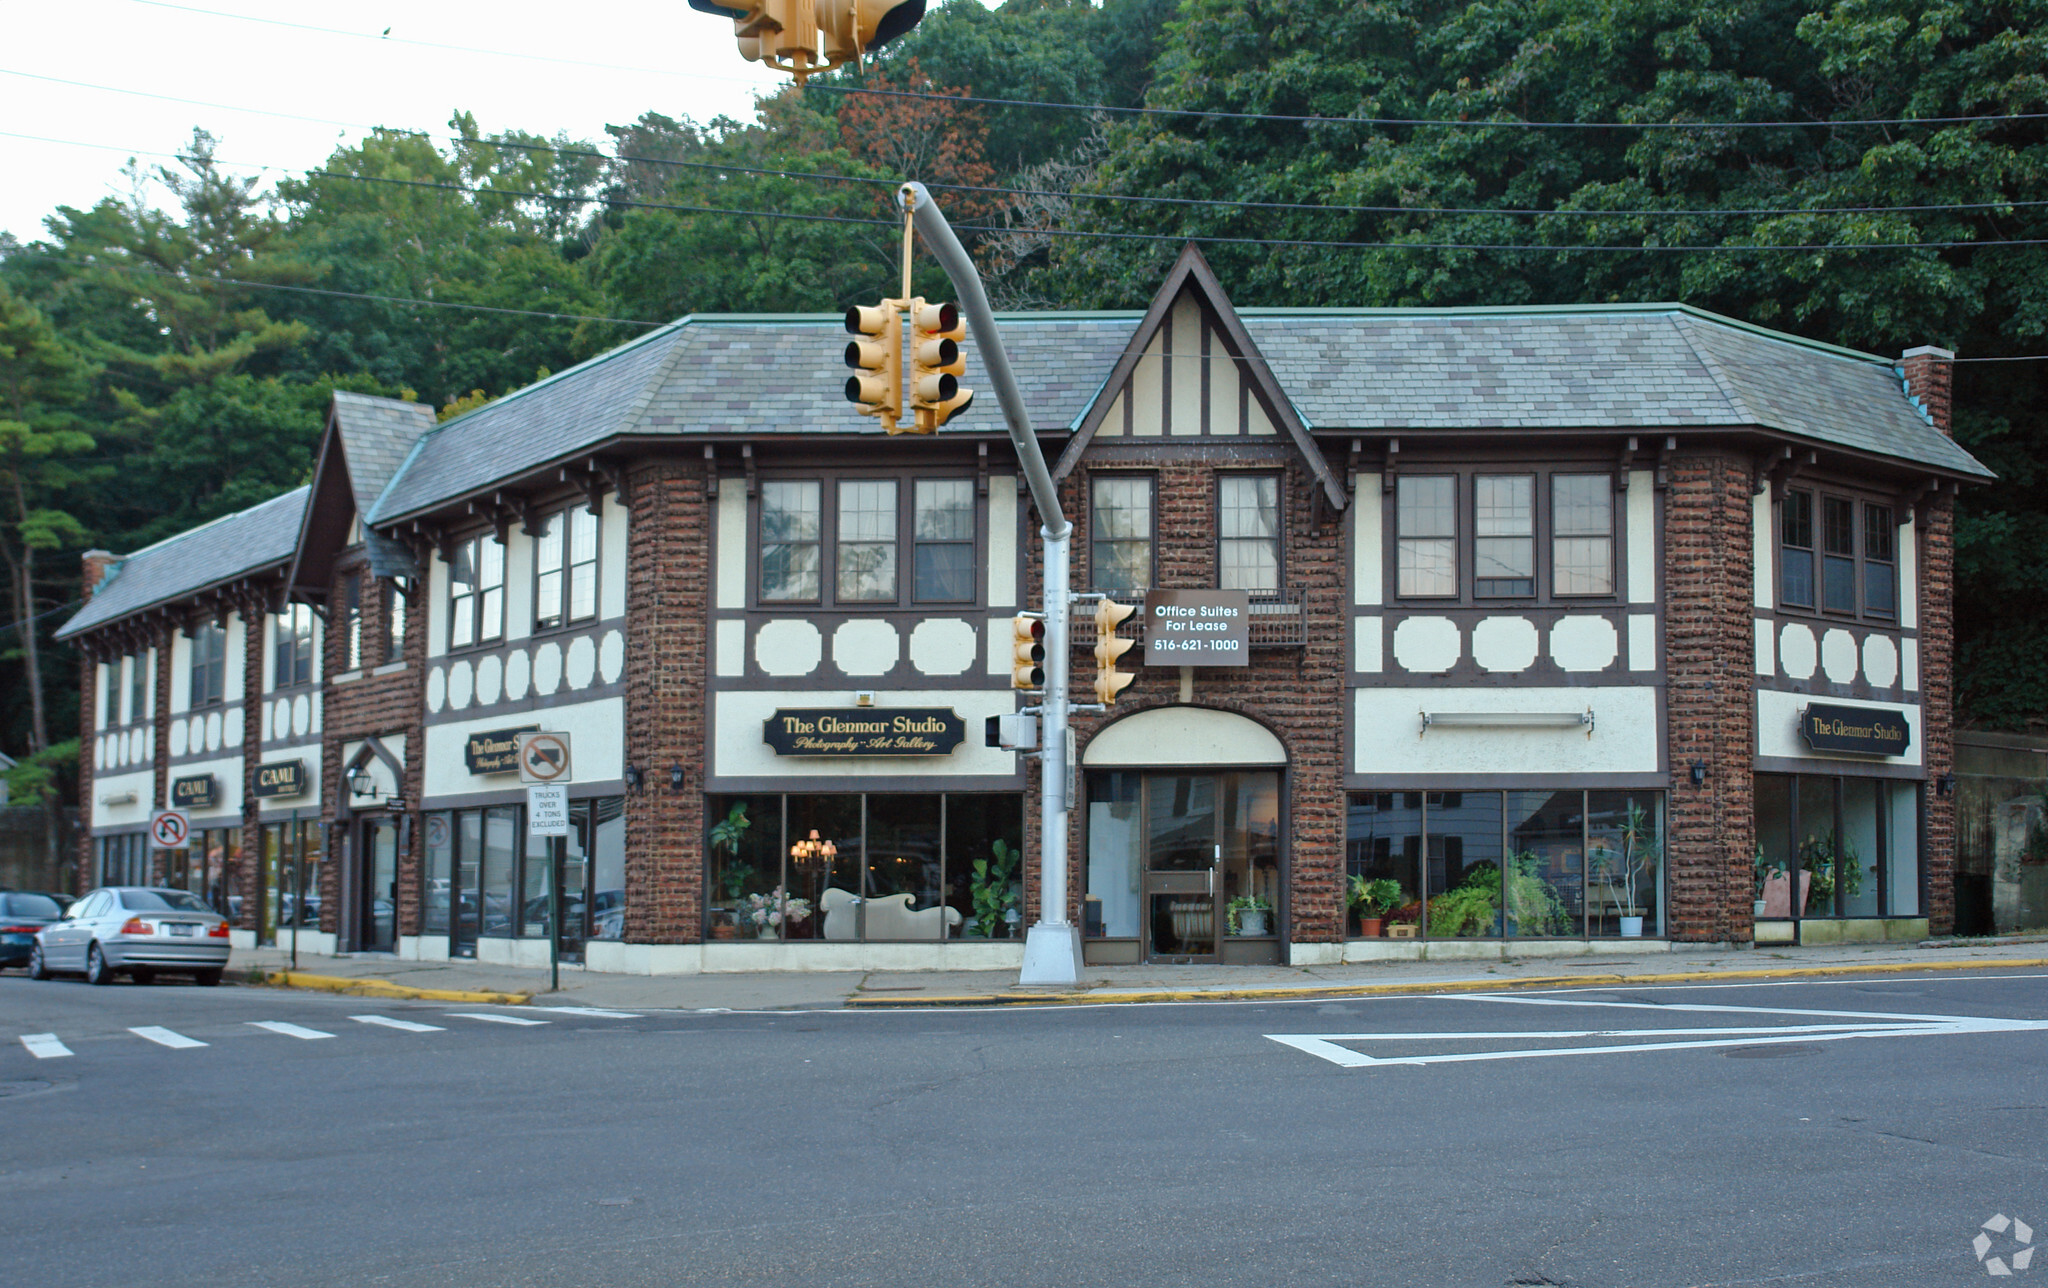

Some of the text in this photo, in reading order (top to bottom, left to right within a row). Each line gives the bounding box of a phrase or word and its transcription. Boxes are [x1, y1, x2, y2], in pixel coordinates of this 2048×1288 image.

[1155, 605, 1239, 617] Office Suites
[1166, 620, 1228, 631] For Lease
[1154, 639, 1239, 651] 516-621-1000
[783, 716, 947, 734] The Glenmar Studio
[1813, 717, 1902, 741] The Glenmar Studio
[471, 740, 484, 755] The
[793, 736, 938, 752] Photography Art Gallery
[261, 767, 294, 786] CAMI
[178, 780, 207, 796] CAMI
[532, 820, 565, 828] EXCLUDED
